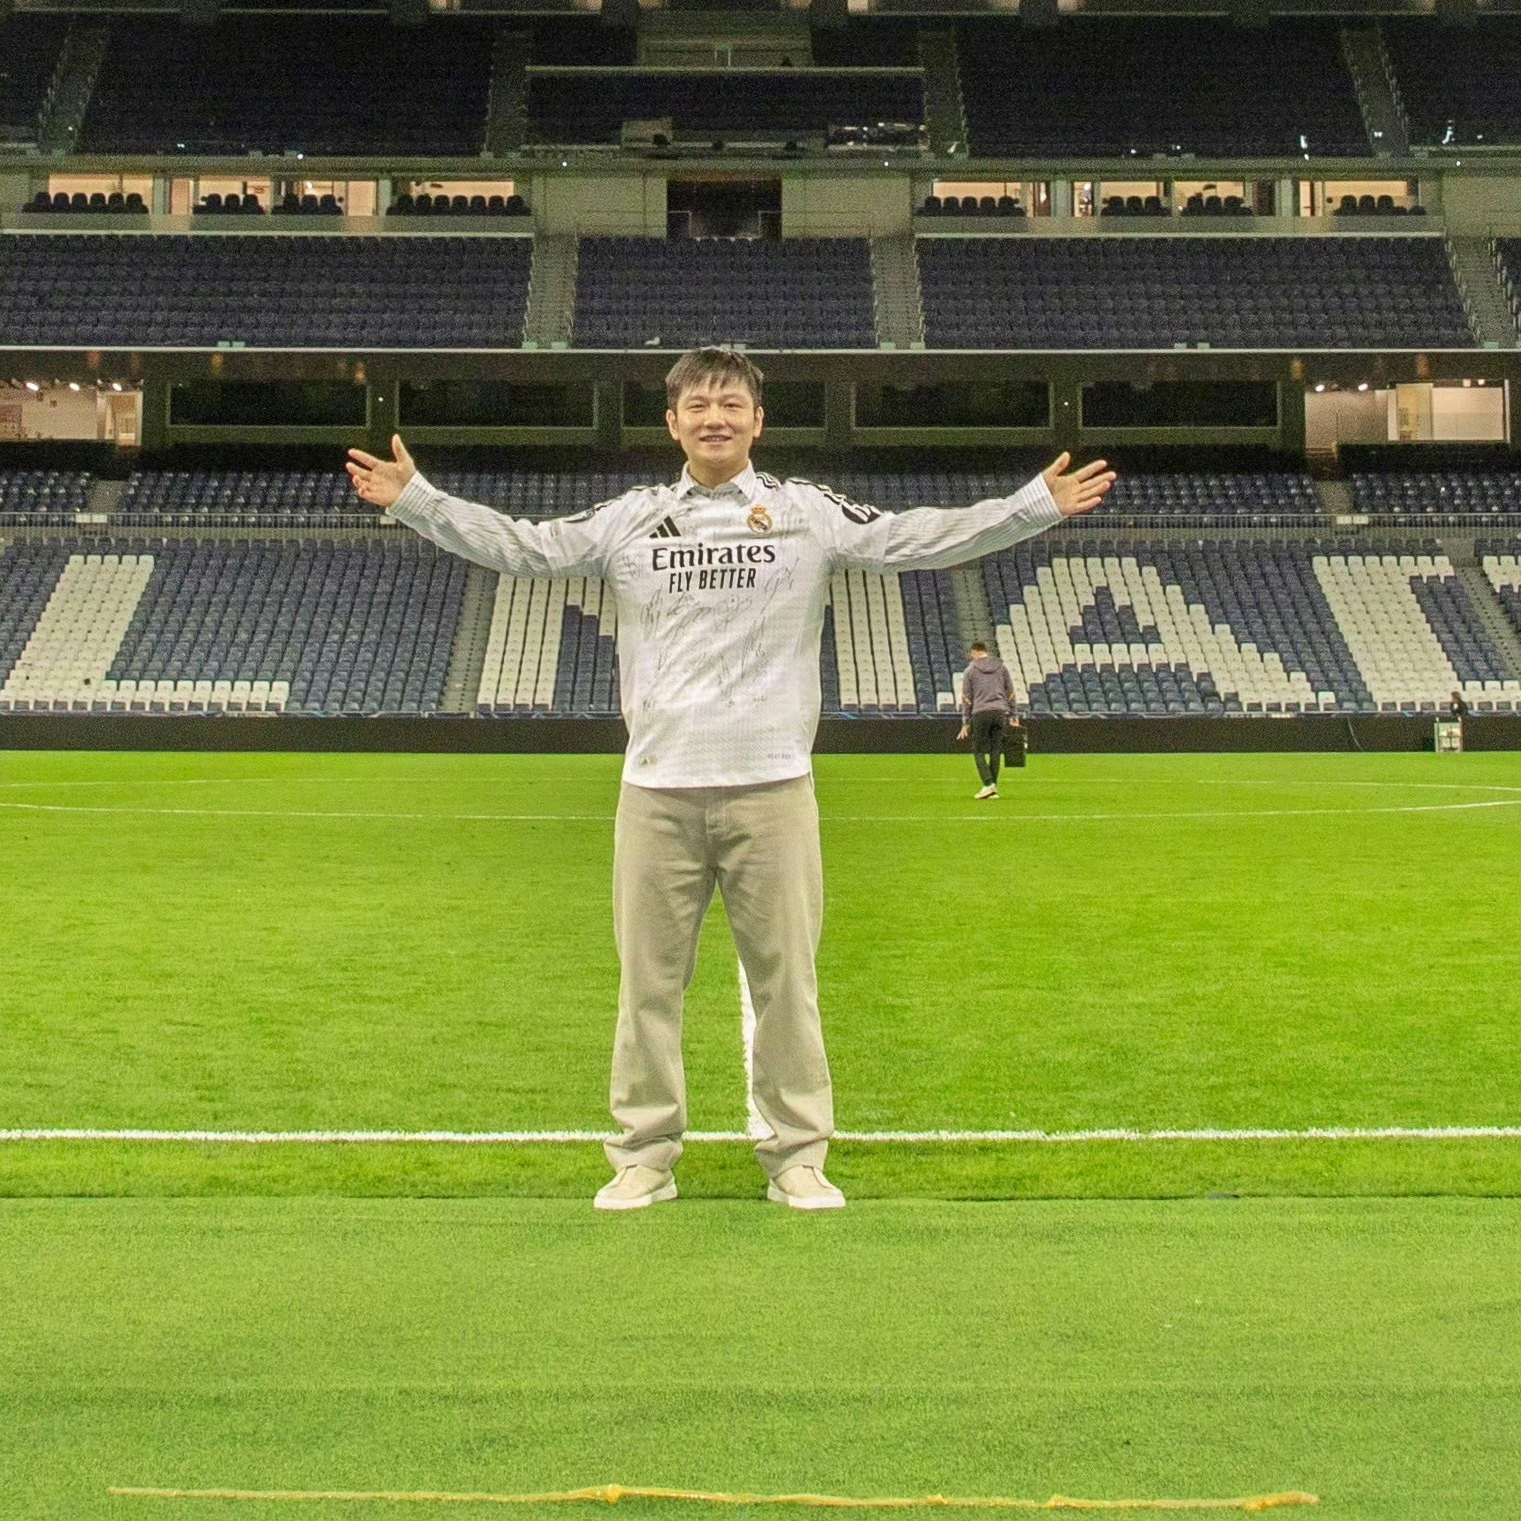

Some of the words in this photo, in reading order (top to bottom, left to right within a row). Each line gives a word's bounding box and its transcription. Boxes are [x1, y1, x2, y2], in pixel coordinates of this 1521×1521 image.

[652, 543, 775, 571] Emirates
[669, 571, 692, 593] FLY
[699, 568, 756, 589] BETTER
